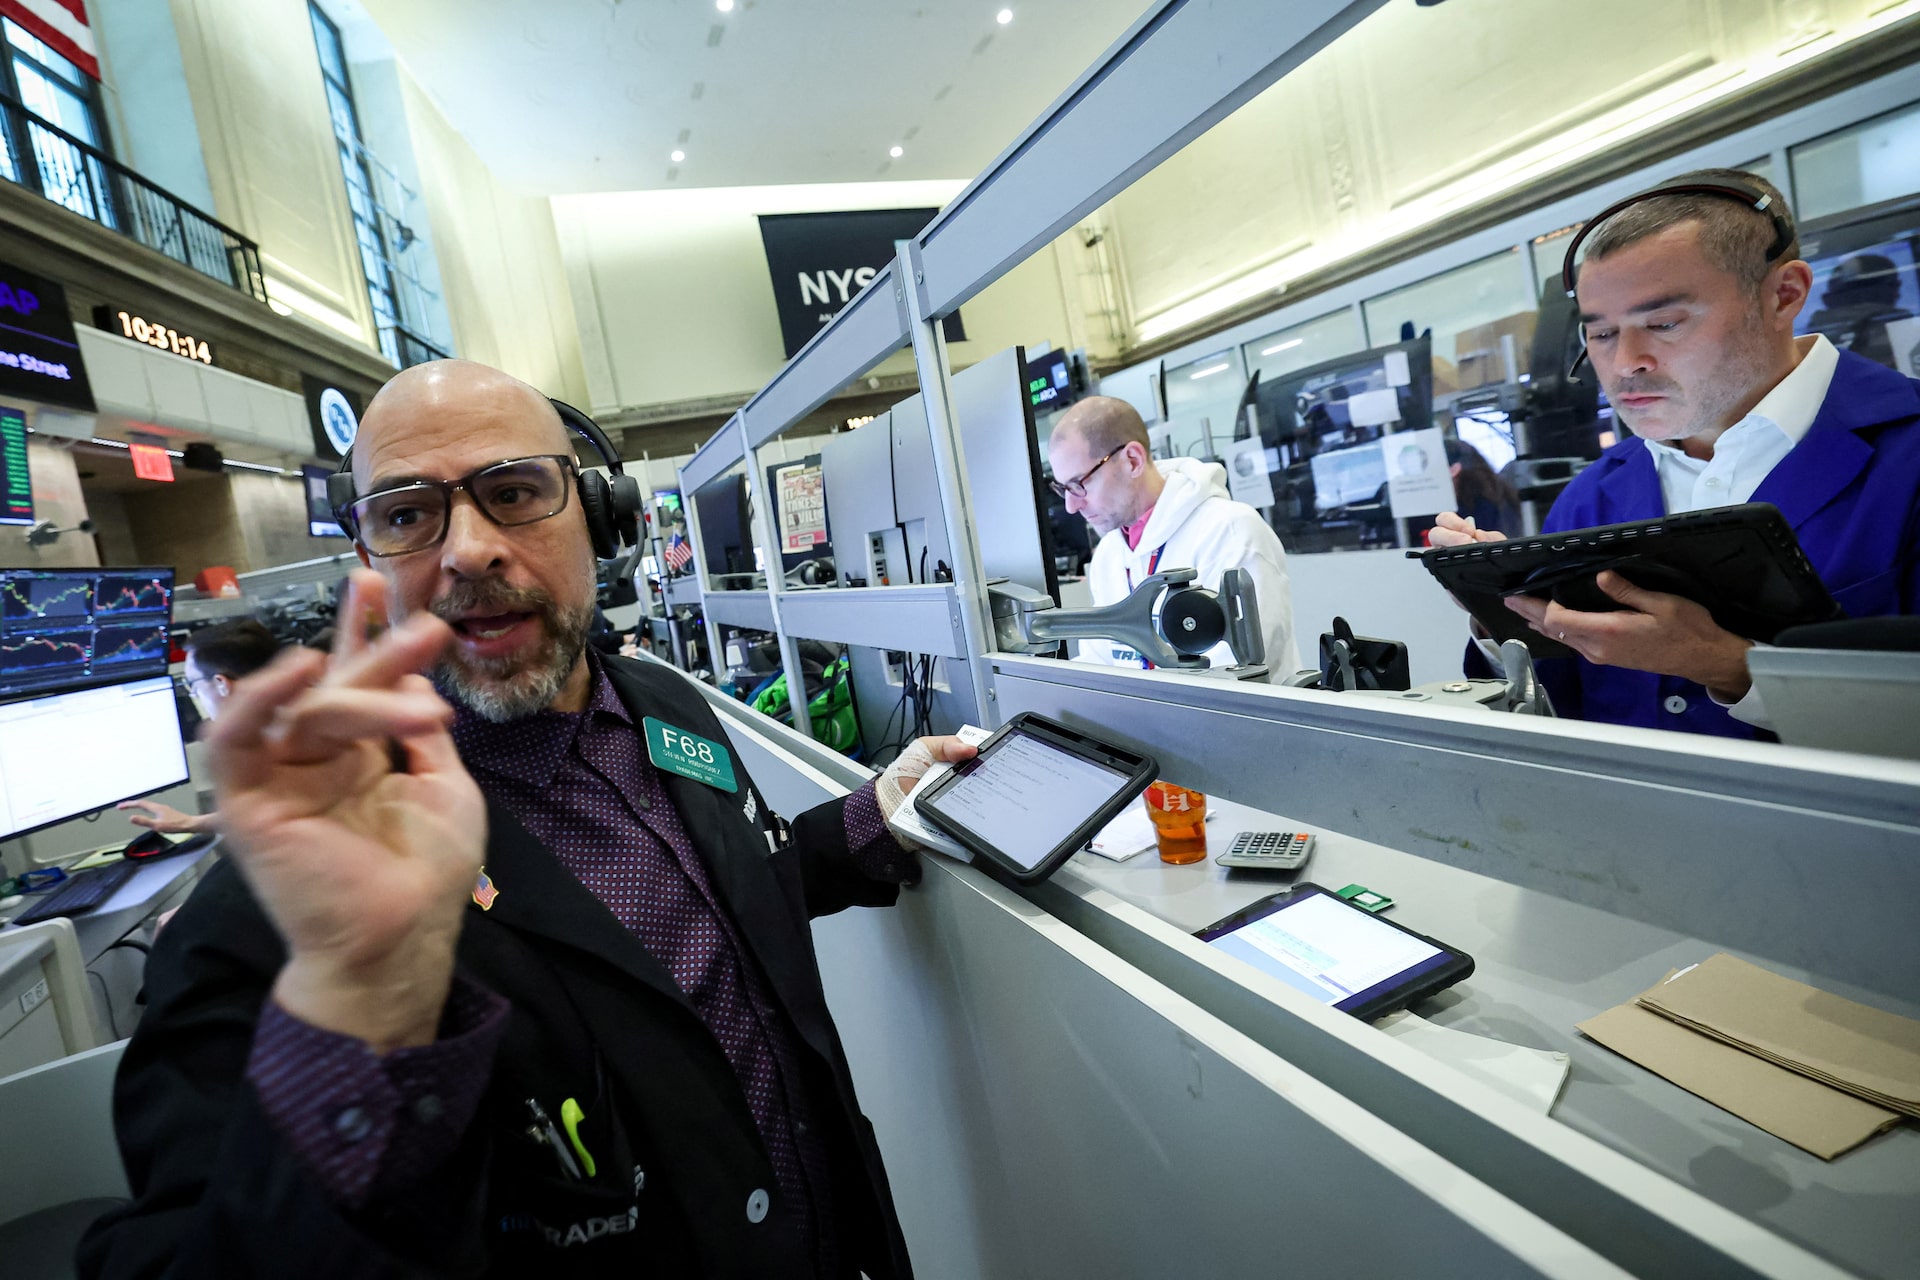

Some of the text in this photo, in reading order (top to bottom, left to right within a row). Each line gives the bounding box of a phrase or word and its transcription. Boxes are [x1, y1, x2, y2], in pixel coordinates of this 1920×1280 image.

[117, 311, 212, 365] 10:31:14
[18, 353, 71, 380] Street
[662, 727, 714, 763] F68
[962, 729, 977, 737] BUY
